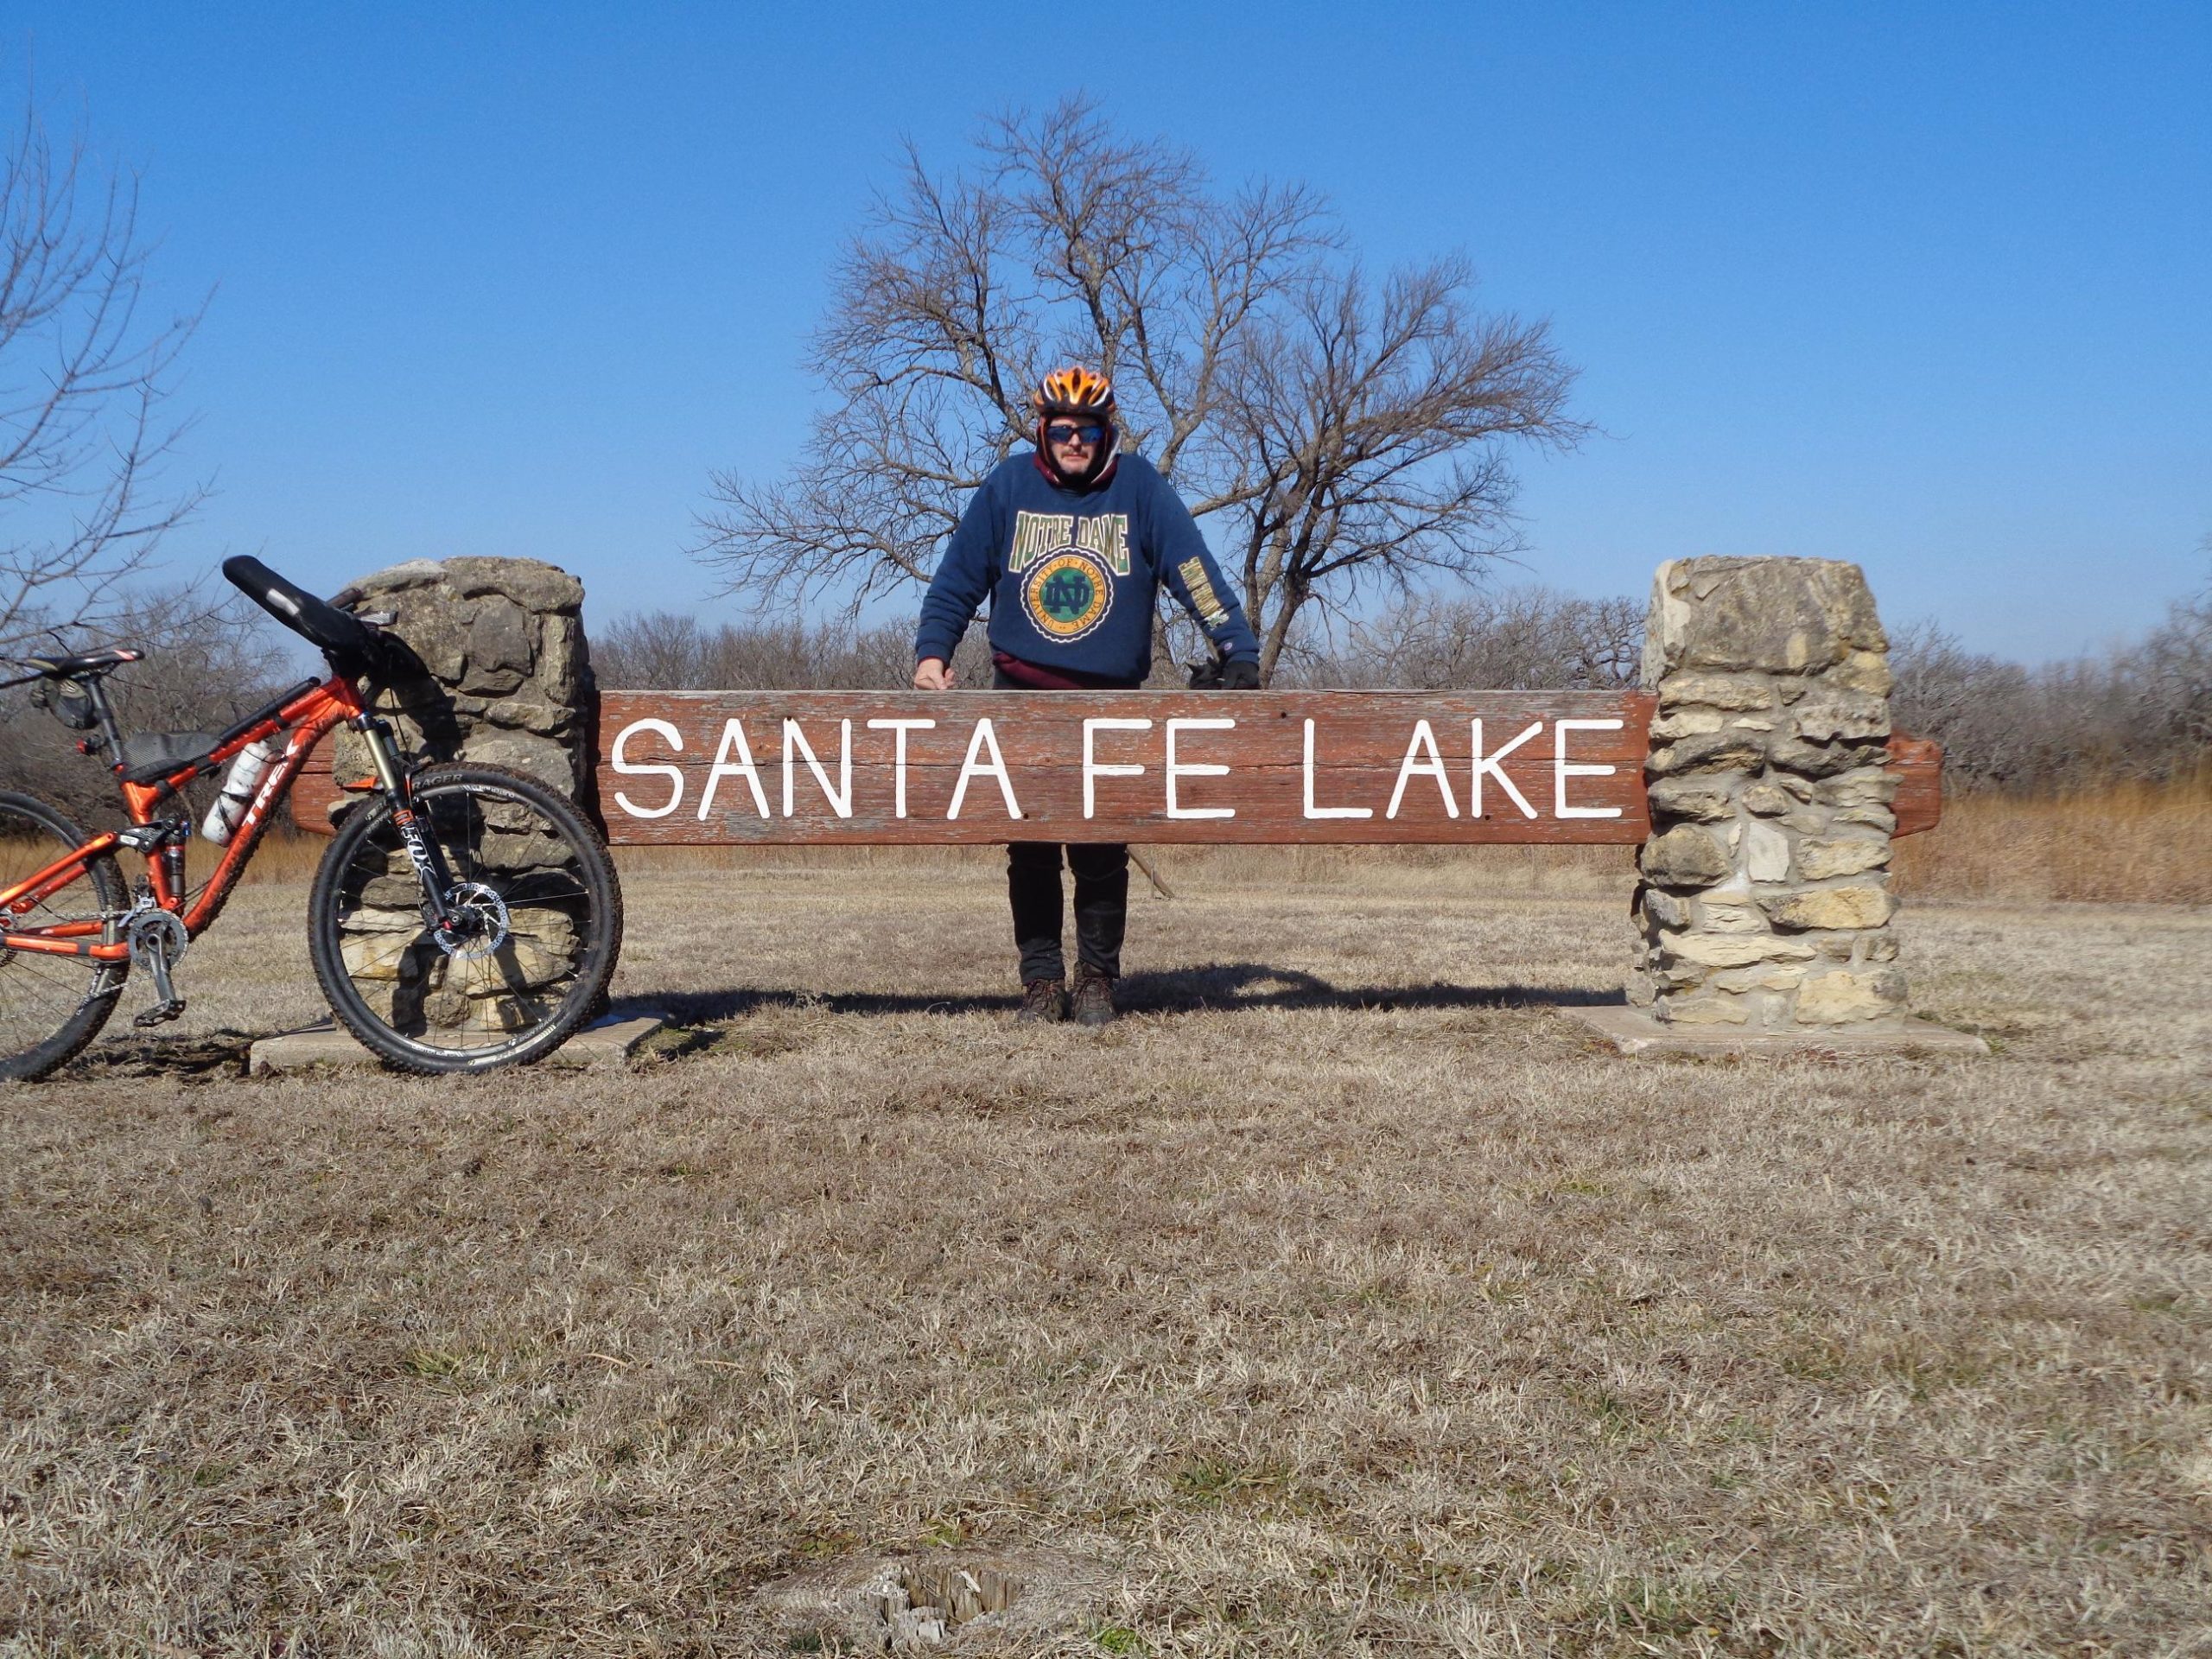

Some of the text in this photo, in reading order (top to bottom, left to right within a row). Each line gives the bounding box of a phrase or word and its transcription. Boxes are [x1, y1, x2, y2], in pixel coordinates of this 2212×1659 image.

[1008, 510, 1074, 574] NOTRE
[1076, 513, 1130, 576] DAME
[1031, 558, 1104, 630] UNIVERSITY OF NOTRE DAME
[242, 739, 299, 826] TREK
[612, 718, 1624, 821] SANTA FE LAKE
[401, 826, 437, 880] FOX
